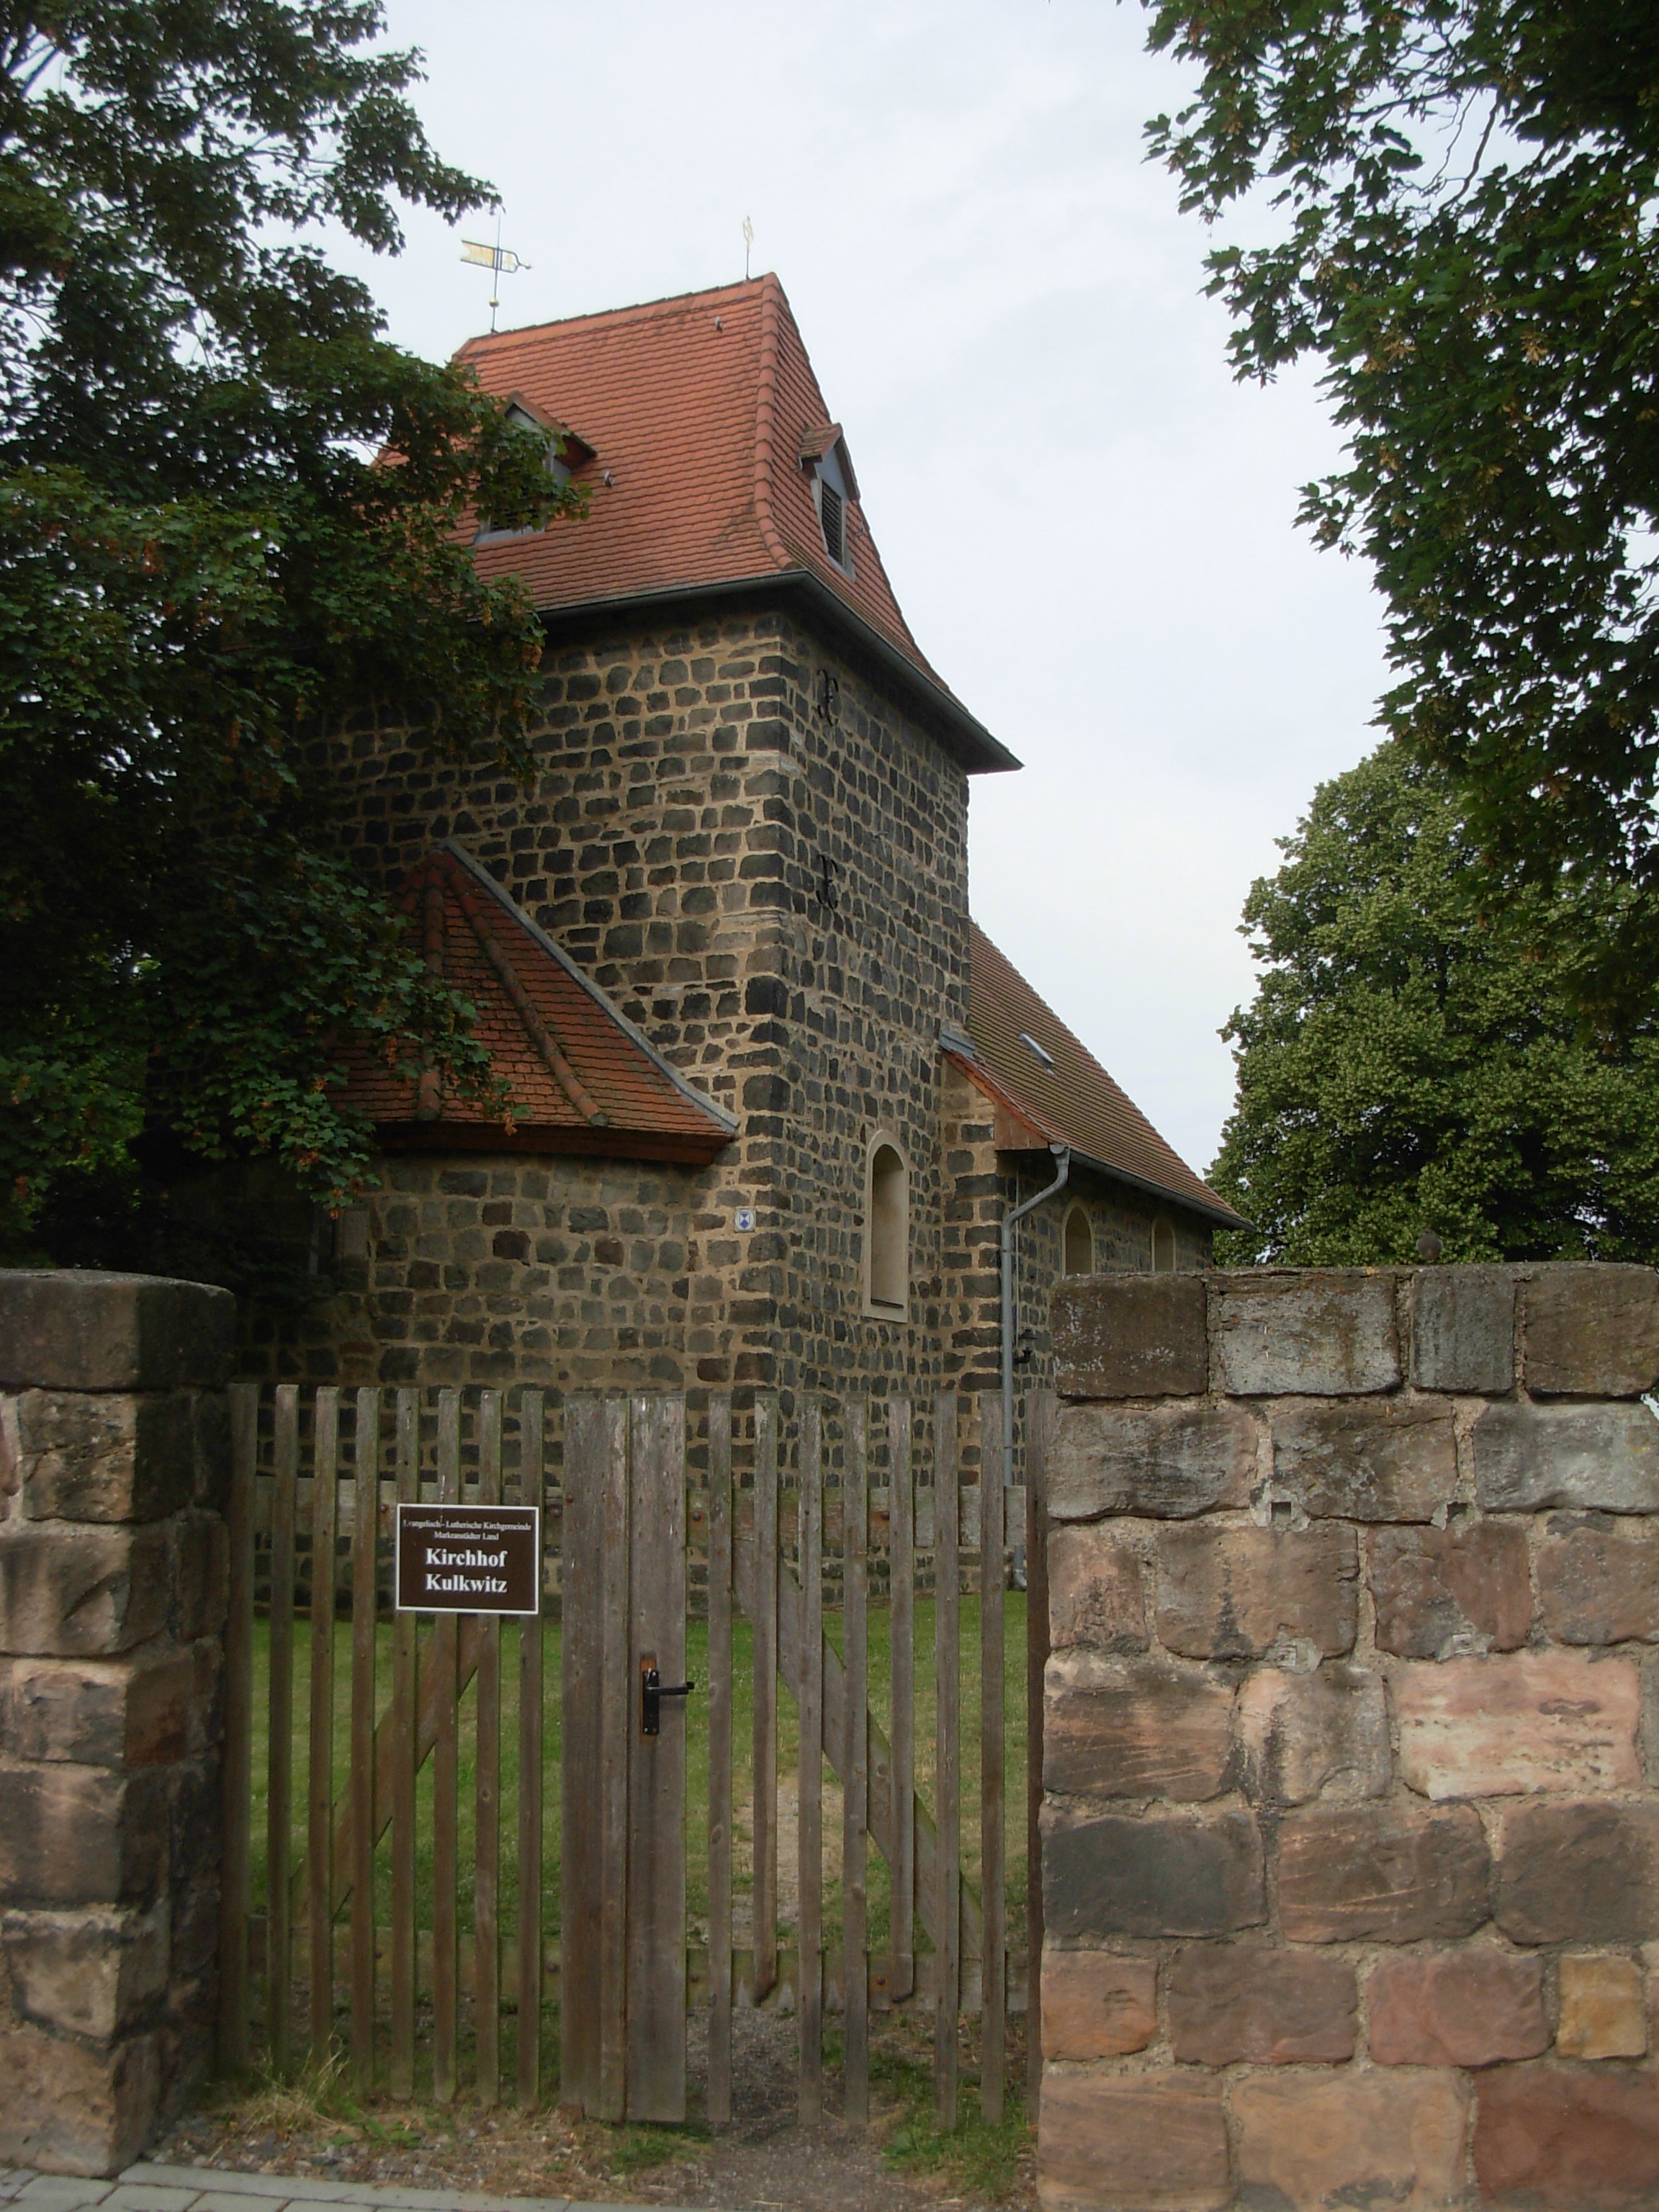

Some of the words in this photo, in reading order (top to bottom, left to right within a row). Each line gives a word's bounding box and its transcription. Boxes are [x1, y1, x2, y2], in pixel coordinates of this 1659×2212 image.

[483, 1521, 531, 1532] Kirchgemeinde
[426, 1547, 508, 1567] Kirchhof
[426, 1573, 508, 1593] Kulkwitz
